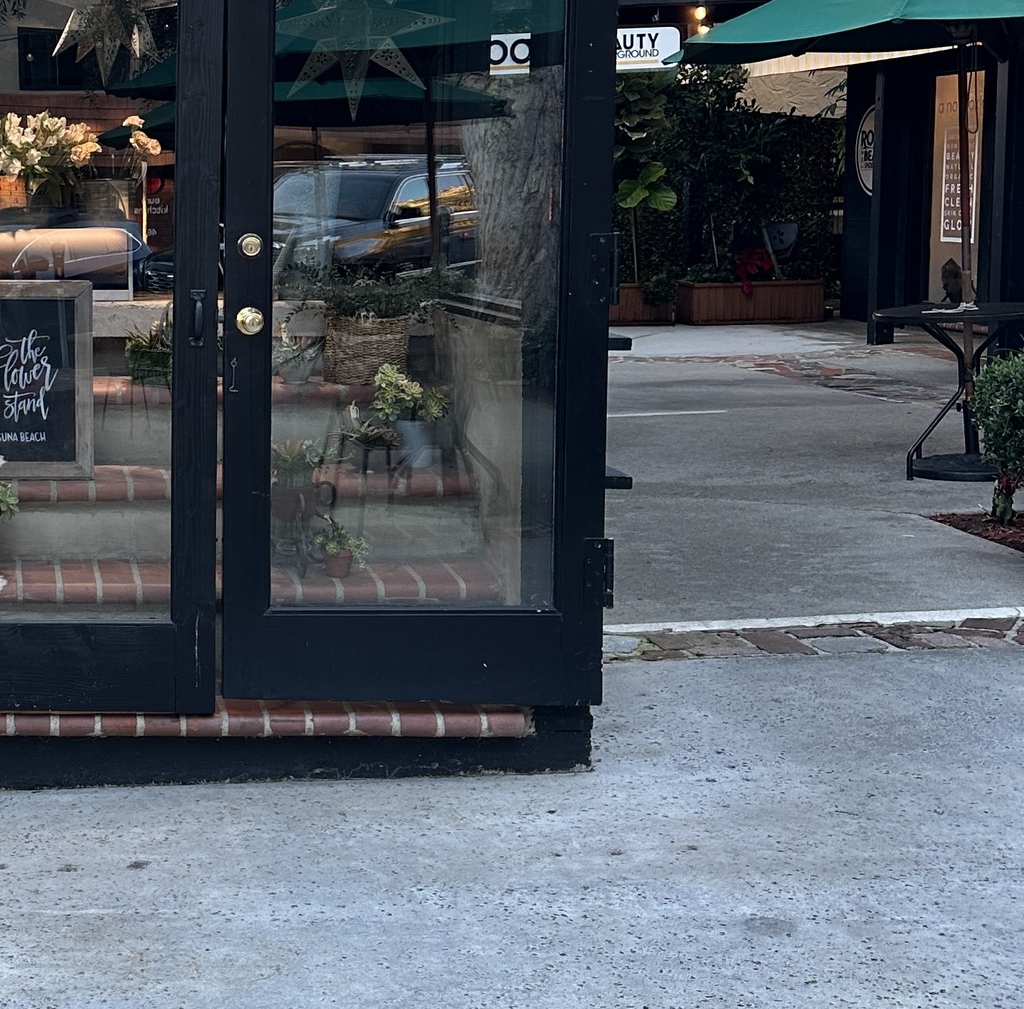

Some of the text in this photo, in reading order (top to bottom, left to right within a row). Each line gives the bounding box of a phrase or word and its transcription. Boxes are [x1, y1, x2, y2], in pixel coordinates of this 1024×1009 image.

[5, 329, 50, 365] the
[3, 386, 49, 422] stand
[20, 431, 47, 442] BEACH
